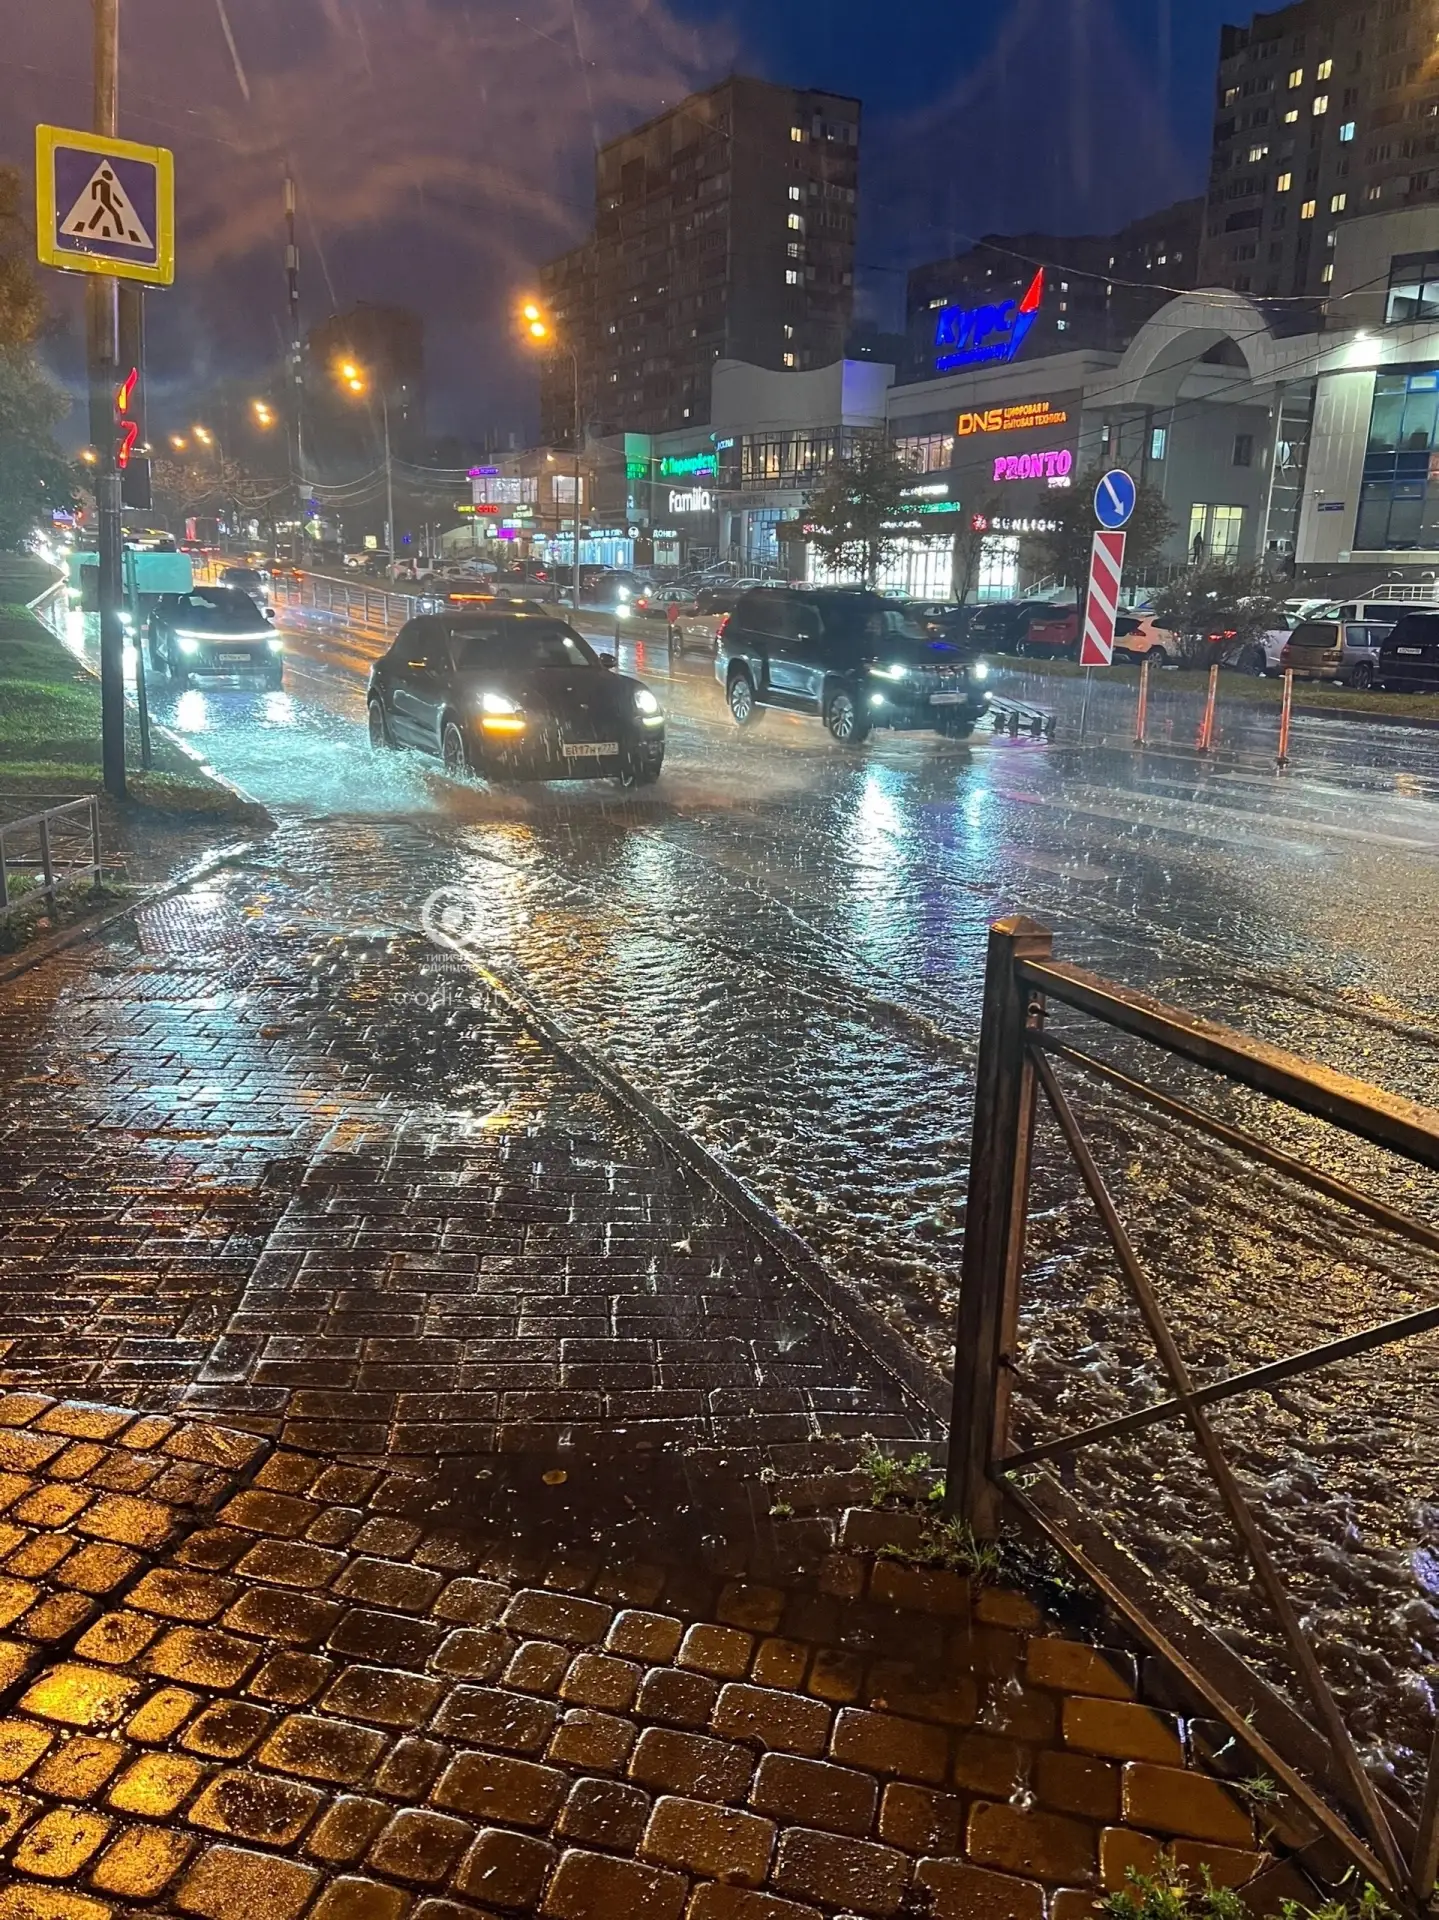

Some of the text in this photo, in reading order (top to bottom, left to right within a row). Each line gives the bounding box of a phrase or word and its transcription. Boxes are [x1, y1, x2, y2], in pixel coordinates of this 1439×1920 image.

[936, 299, 1016, 348] Курс
[958, 409, 1003, 435] DNS
[994, 449, 1072, 481] PRONTO
